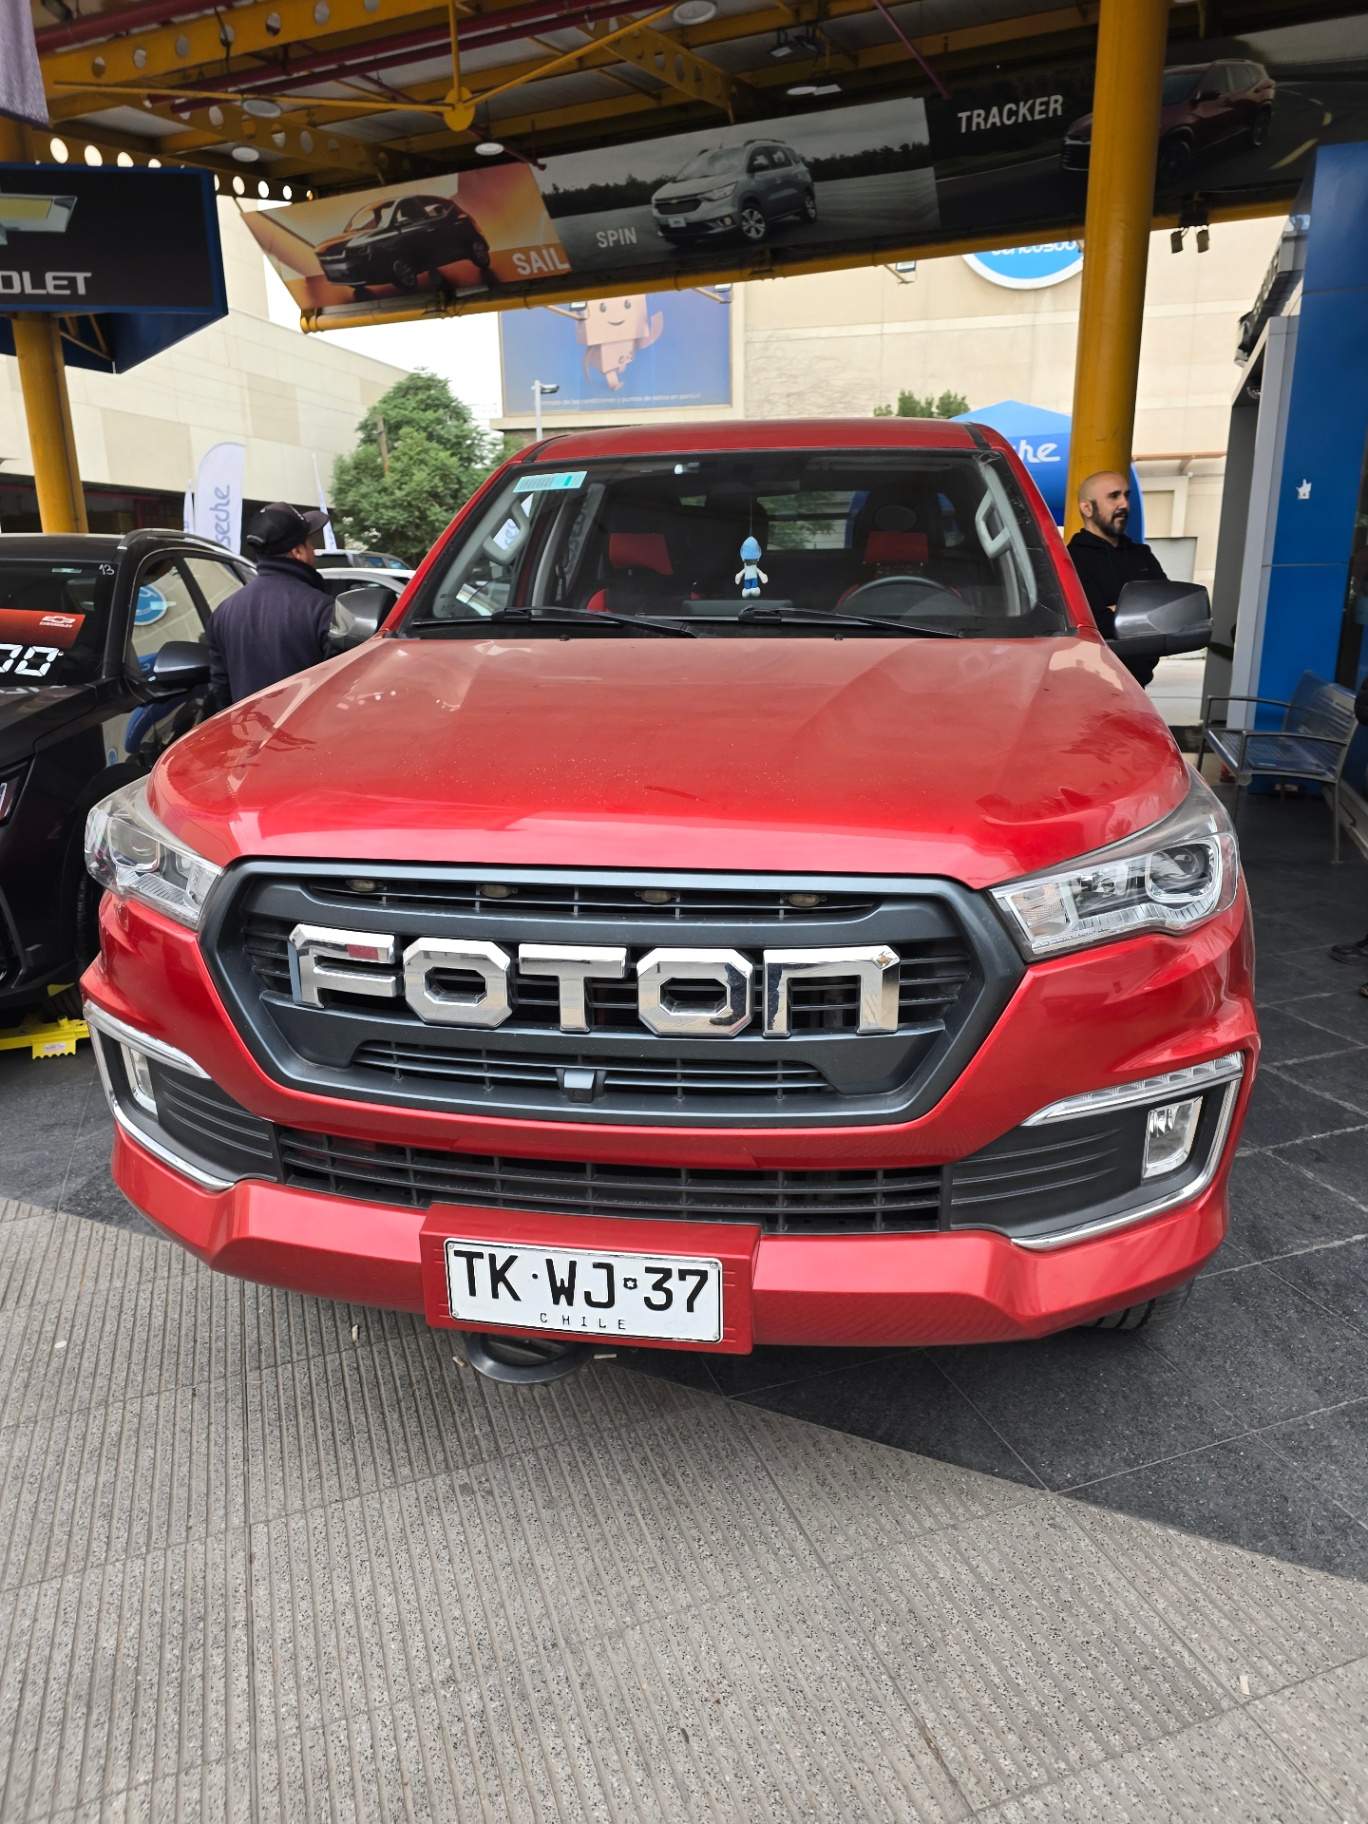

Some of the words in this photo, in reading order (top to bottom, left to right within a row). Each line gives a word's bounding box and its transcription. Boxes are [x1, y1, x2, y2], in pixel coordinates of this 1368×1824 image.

[957, 94, 1063, 133] TRACKER
[596, 226, 638, 248] SPIN
[511, 247, 571, 275] SAIL
[1012, 439, 1061, 463] he
[288, 923, 902, 1040] FOTON
[539, 1312, 627, 1331] CHILE
